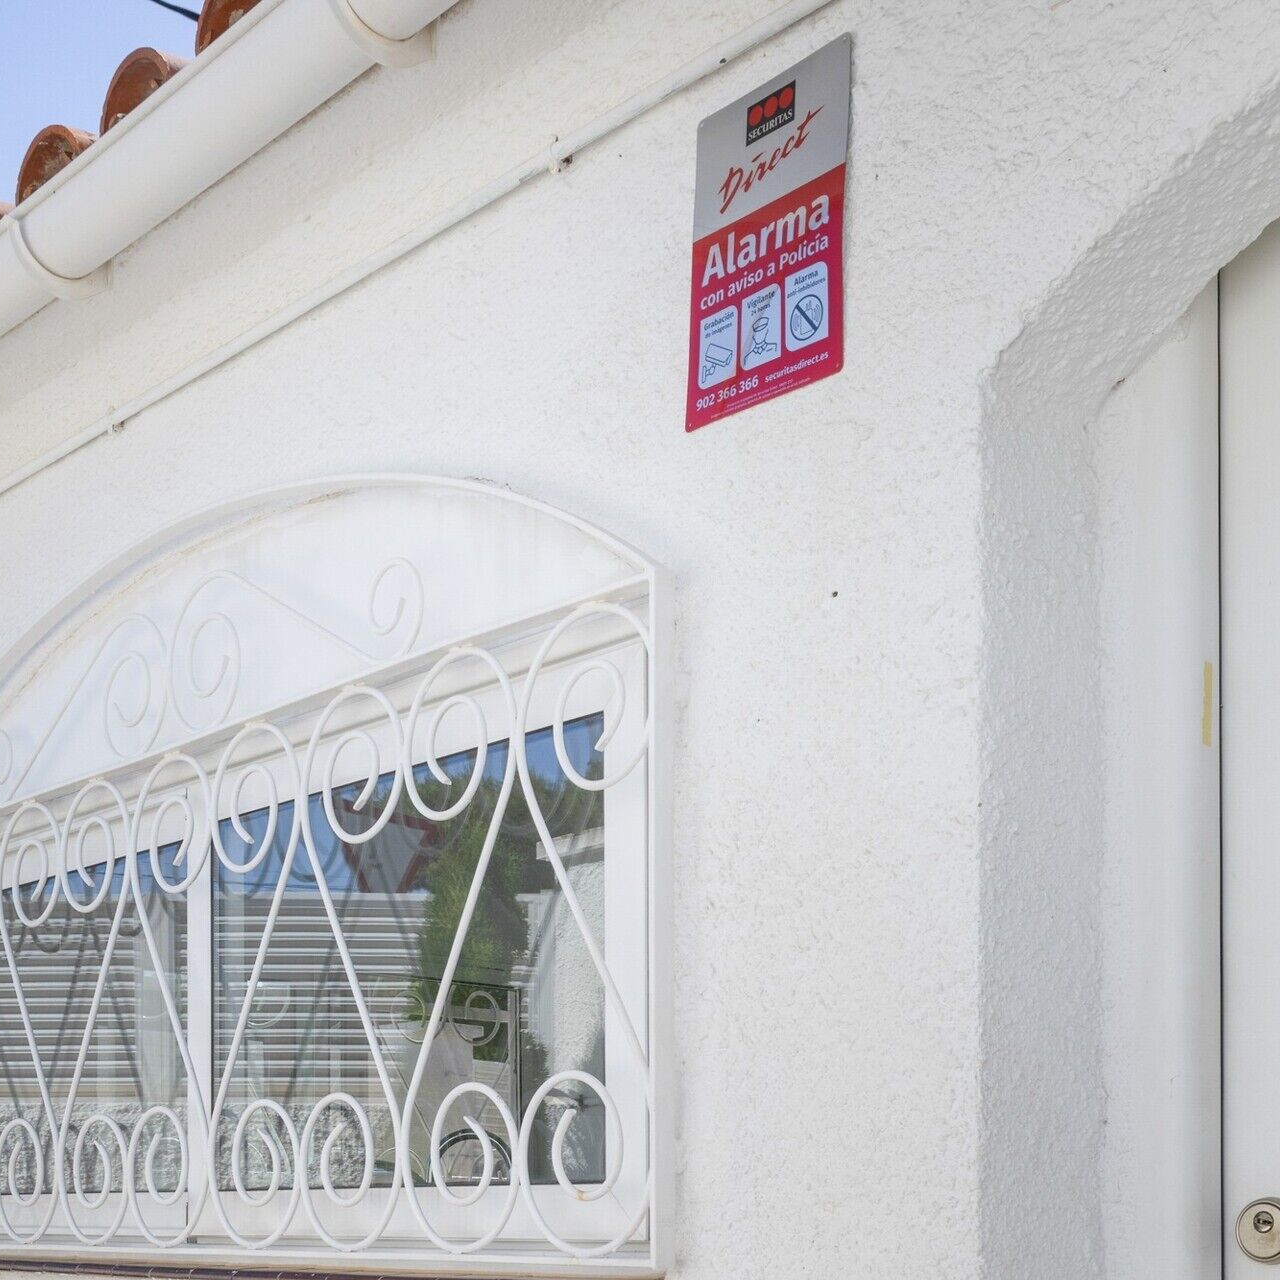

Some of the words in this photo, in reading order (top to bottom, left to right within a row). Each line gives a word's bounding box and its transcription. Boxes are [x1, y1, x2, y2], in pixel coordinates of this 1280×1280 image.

[747, 108, 793, 142] SECURITAS
[718, 105, 825, 214] Direct
[701, 194, 830, 288] Alarma
[700, 290, 724, 310] con
[728, 271, 764, 297] aviso
[767, 263, 775, 276] a
[779, 234, 829, 271] Policía
[793, 269, 819, 286] Alarma
[746, 290, 775, 310] Vigilante
[764, 351, 829, 383] securitasdirect.es
[696, 394, 716, 412] 902
[717, 384, 737, 403] 366
[739, 374, 759, 394] 366
